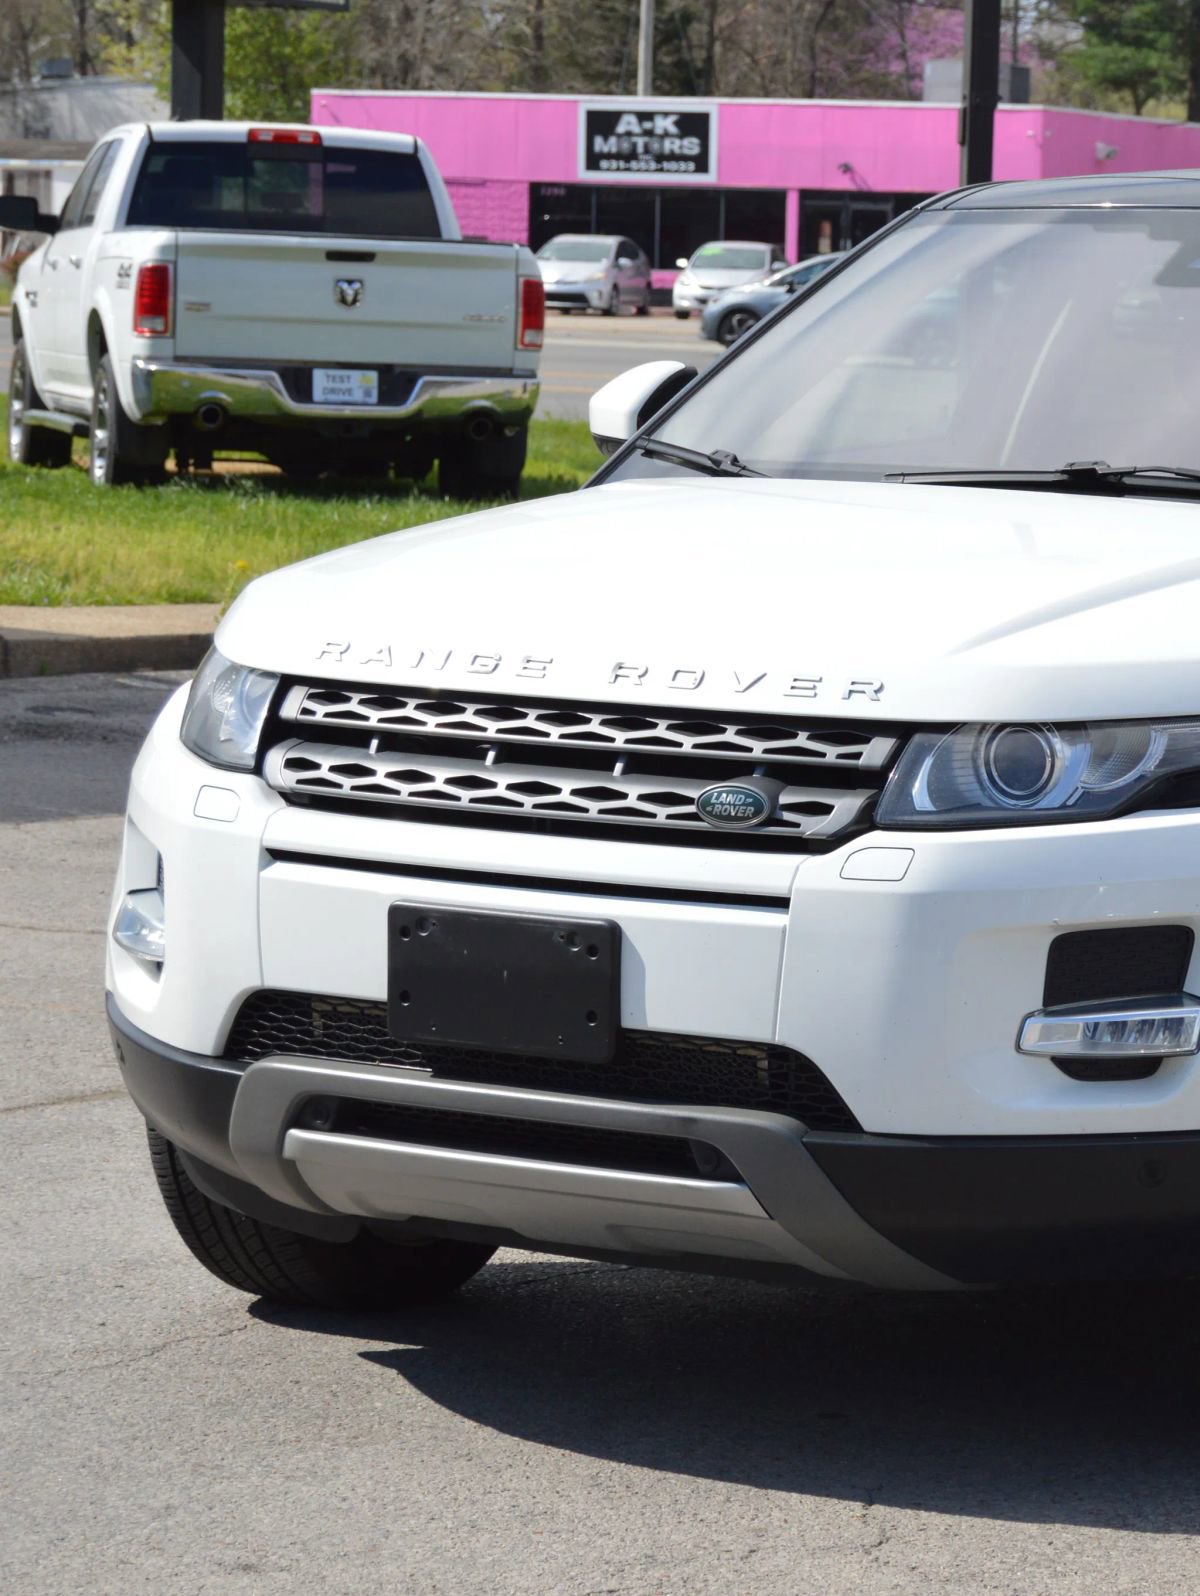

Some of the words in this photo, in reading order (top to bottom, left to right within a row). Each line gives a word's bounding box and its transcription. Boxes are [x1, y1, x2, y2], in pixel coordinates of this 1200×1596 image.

[615, 113, 680, 134] A-K
[593, 135, 701, 155] MOTORS
[325, 374, 352, 384] TEST
[322, 387, 353, 397] DRIVE
[315, 641, 554, 679] RANGE
[607, 660, 885, 702] ROVER
[710, 792, 745, 805] LAND
[712, 804, 755, 818] ROVER
